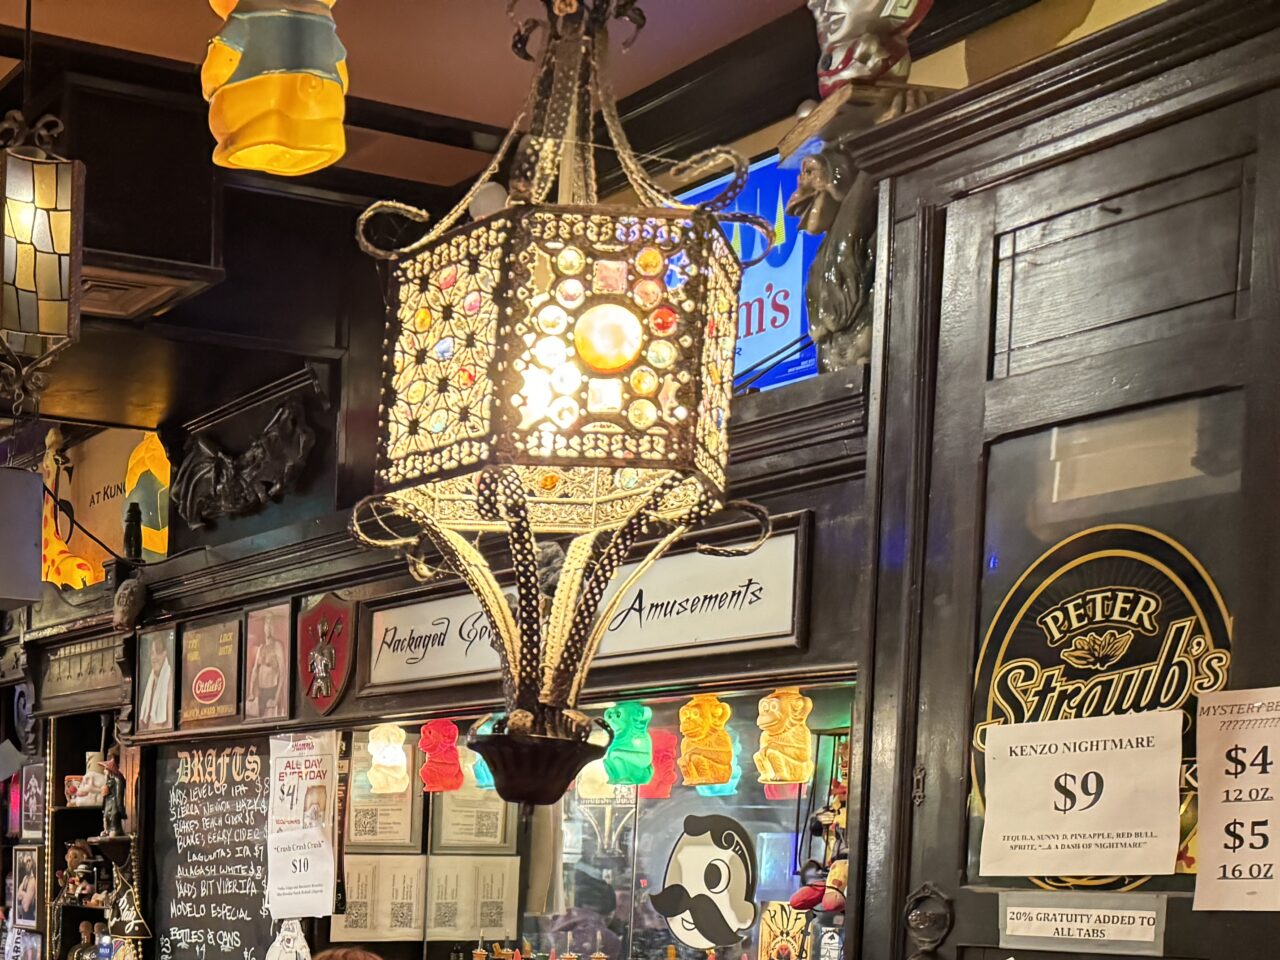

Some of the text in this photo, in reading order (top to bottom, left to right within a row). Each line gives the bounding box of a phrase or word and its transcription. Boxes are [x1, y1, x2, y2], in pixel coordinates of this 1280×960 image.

[89, 491, 101, 508] AT
[608, 577, 764, 632] Amusements
[1042, 591, 1158, 641] PETER
[373, 617, 451, 671] Packaged
[988, 616, 1232, 726] Straub's
[1199, 701, 1264, 717] MYSTERY
[1009, 735, 1156, 758] KENZO NIGHTMARE
[175, 744, 262, 787] DRAFTS
[284, 758, 323, 771] ALL DAY
[1224, 743, 1274, 779] $4
[189, 785, 213, 801] LEVEL
[231, 784, 249, 798] IPA
[279, 783, 299, 811] $4
[1053, 771, 1105, 815] $9
[1223, 787, 1274, 802] 12 OZ.
[170, 804, 200, 822] SIERRA
[207, 828, 232, 845] BERRY
[233, 827, 260, 842] CIDER
[1116, 831, 1133, 839] RED
[1223, 818, 1270, 853] $5
[291, 842, 307, 852] Crush
[1060, 842, 1081, 850] DASH
[176, 864, 218, 879] ALLAGASH
[219, 863, 248, 876] WHITE
[291, 857, 310, 874] $10
[1219, 863, 1274, 879] 16 OZ
[200, 879, 216, 898] BIT
[216, 877, 239, 894] VIPER
[239, 876, 258, 898] IPA
[170, 898, 206, 919] MODELO
[210, 903, 253, 922] ESPECIAL
[1009, 911, 1156, 927] 20% GRATUITY ADDED TO
[169, 926, 205, 944] BOTTLES
[216, 930, 242, 948] CANS
[1053, 926, 1106, 939] ALL TABS
